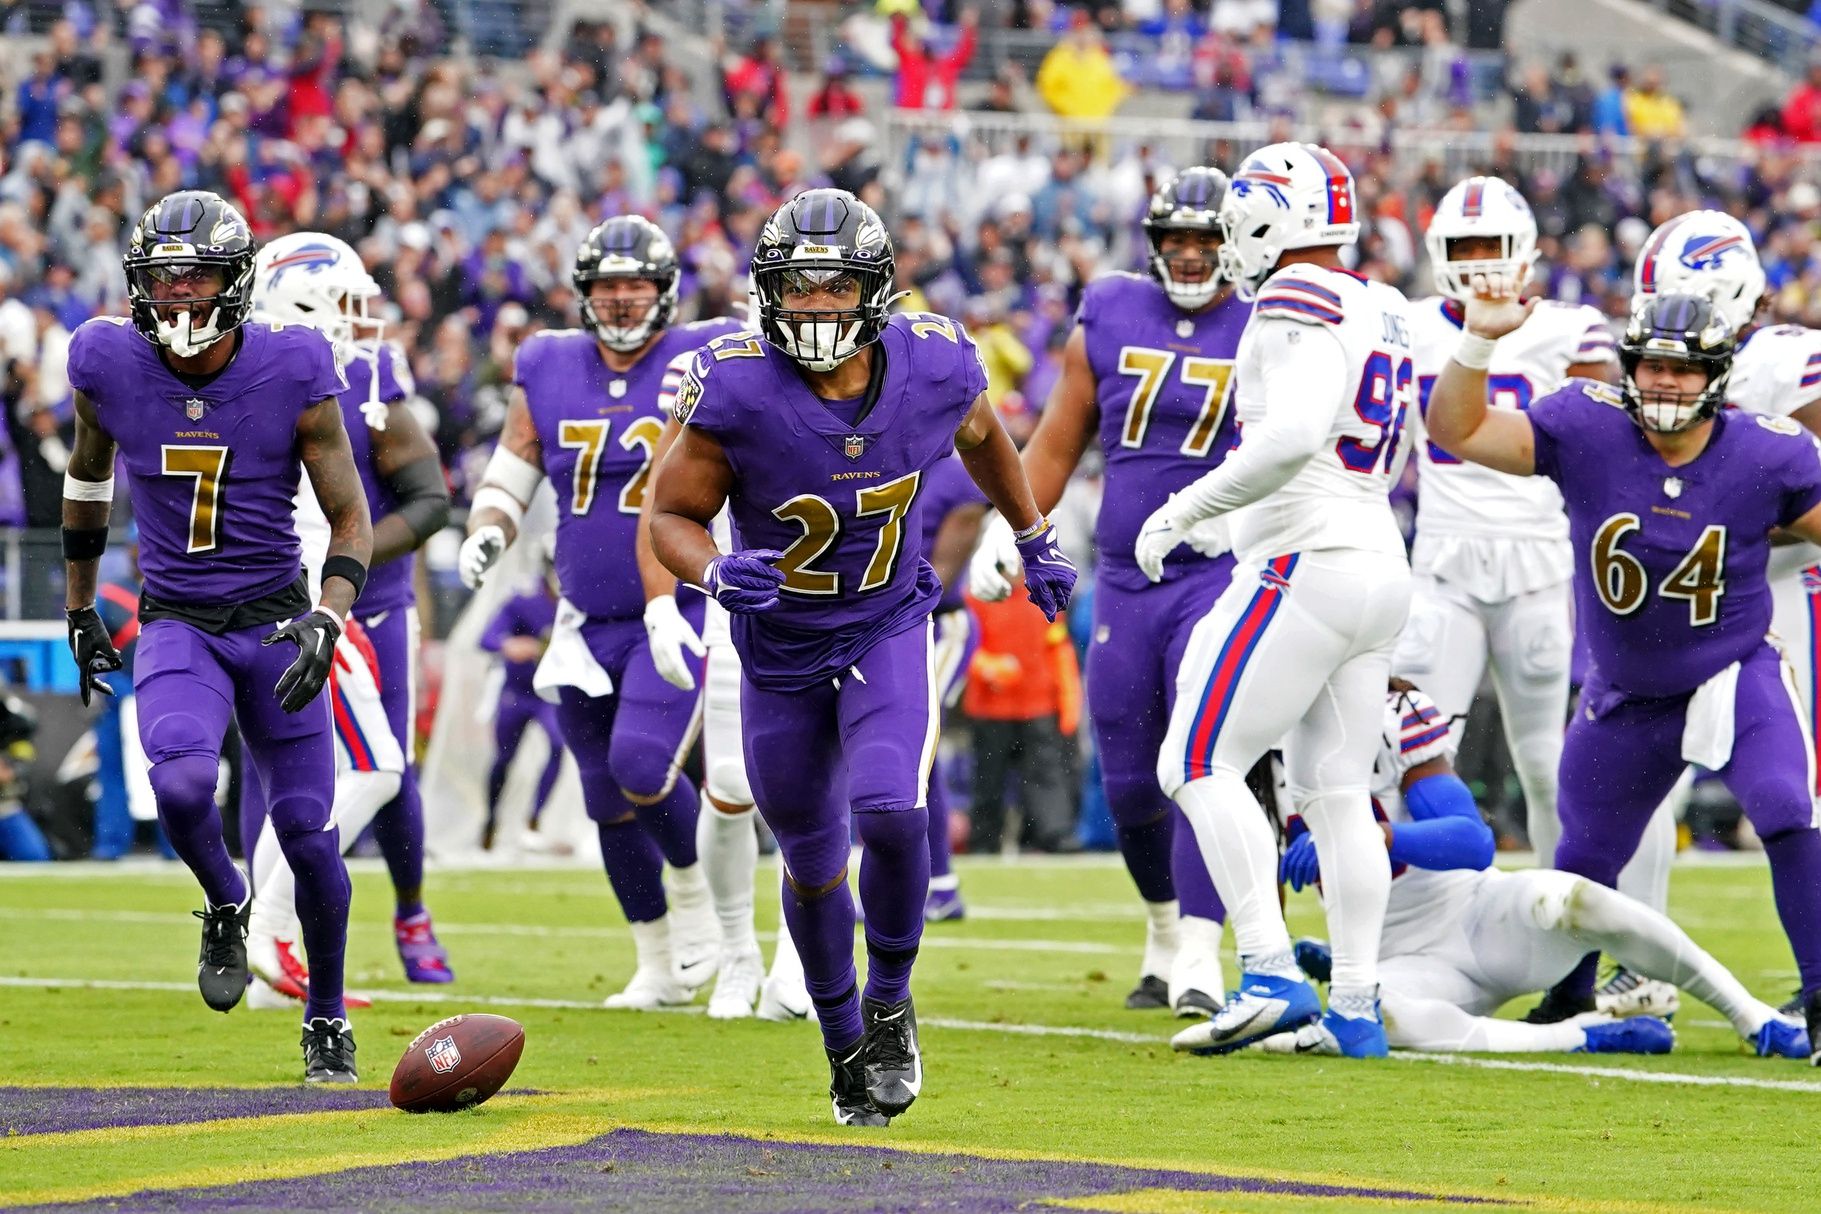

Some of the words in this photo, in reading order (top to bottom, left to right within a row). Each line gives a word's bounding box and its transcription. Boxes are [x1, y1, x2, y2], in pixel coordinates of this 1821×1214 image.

[175, 431, 220, 439] RAVENS
[1118, 346, 1237, 457] 77
[161, 445, 229, 554] 7
[558, 416, 666, 515] 72
[831, 471, 880, 481] RAVENS
[771, 470, 921, 594] 27
[1591, 512, 1726, 627] 64
[433, 1050, 457, 1069] NFL
